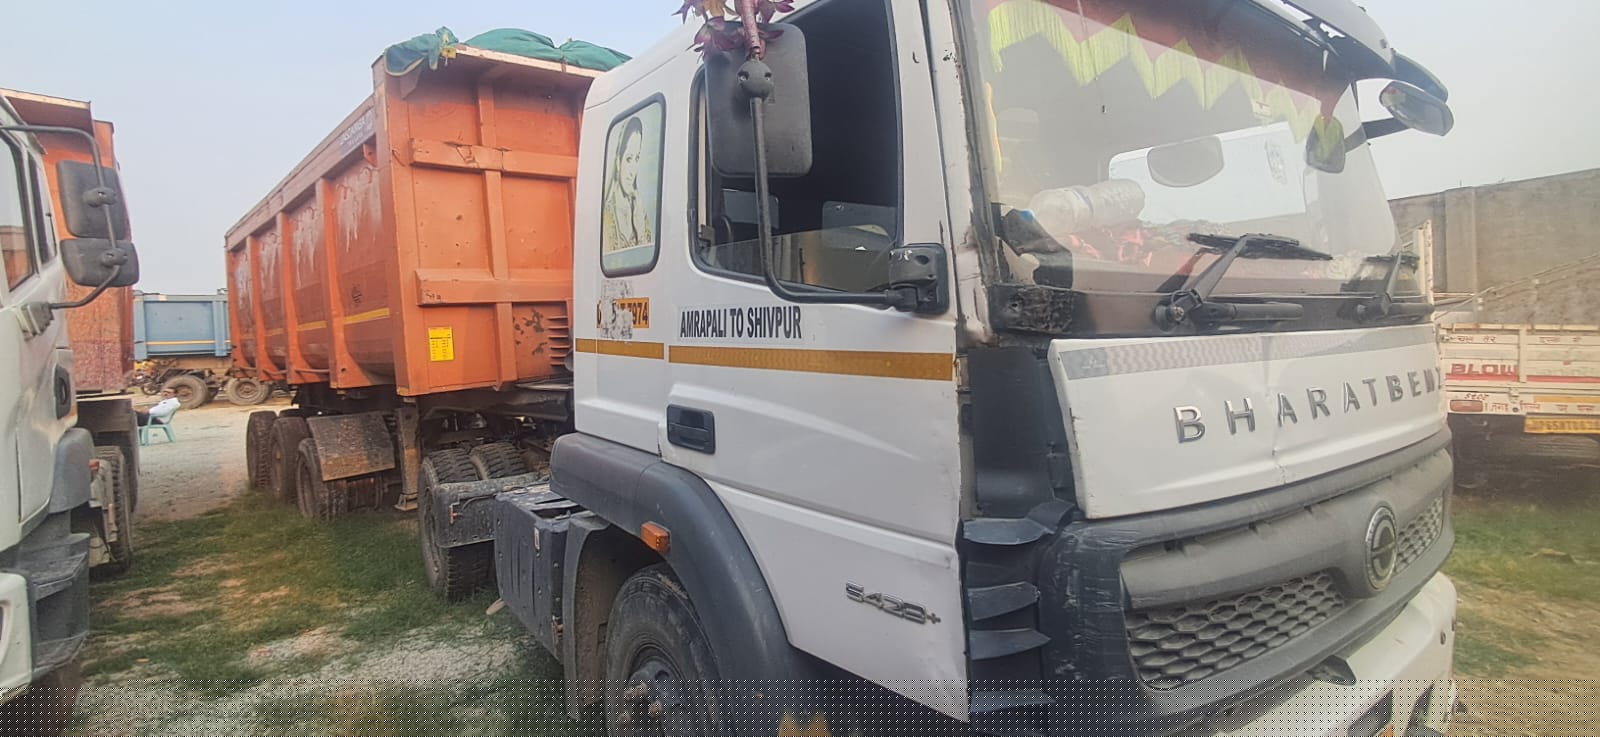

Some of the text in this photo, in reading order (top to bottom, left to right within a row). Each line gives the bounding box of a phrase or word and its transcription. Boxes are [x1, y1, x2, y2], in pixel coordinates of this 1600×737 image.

[680, 305, 802, 339] AMRAPALI TO SHIVPUR
